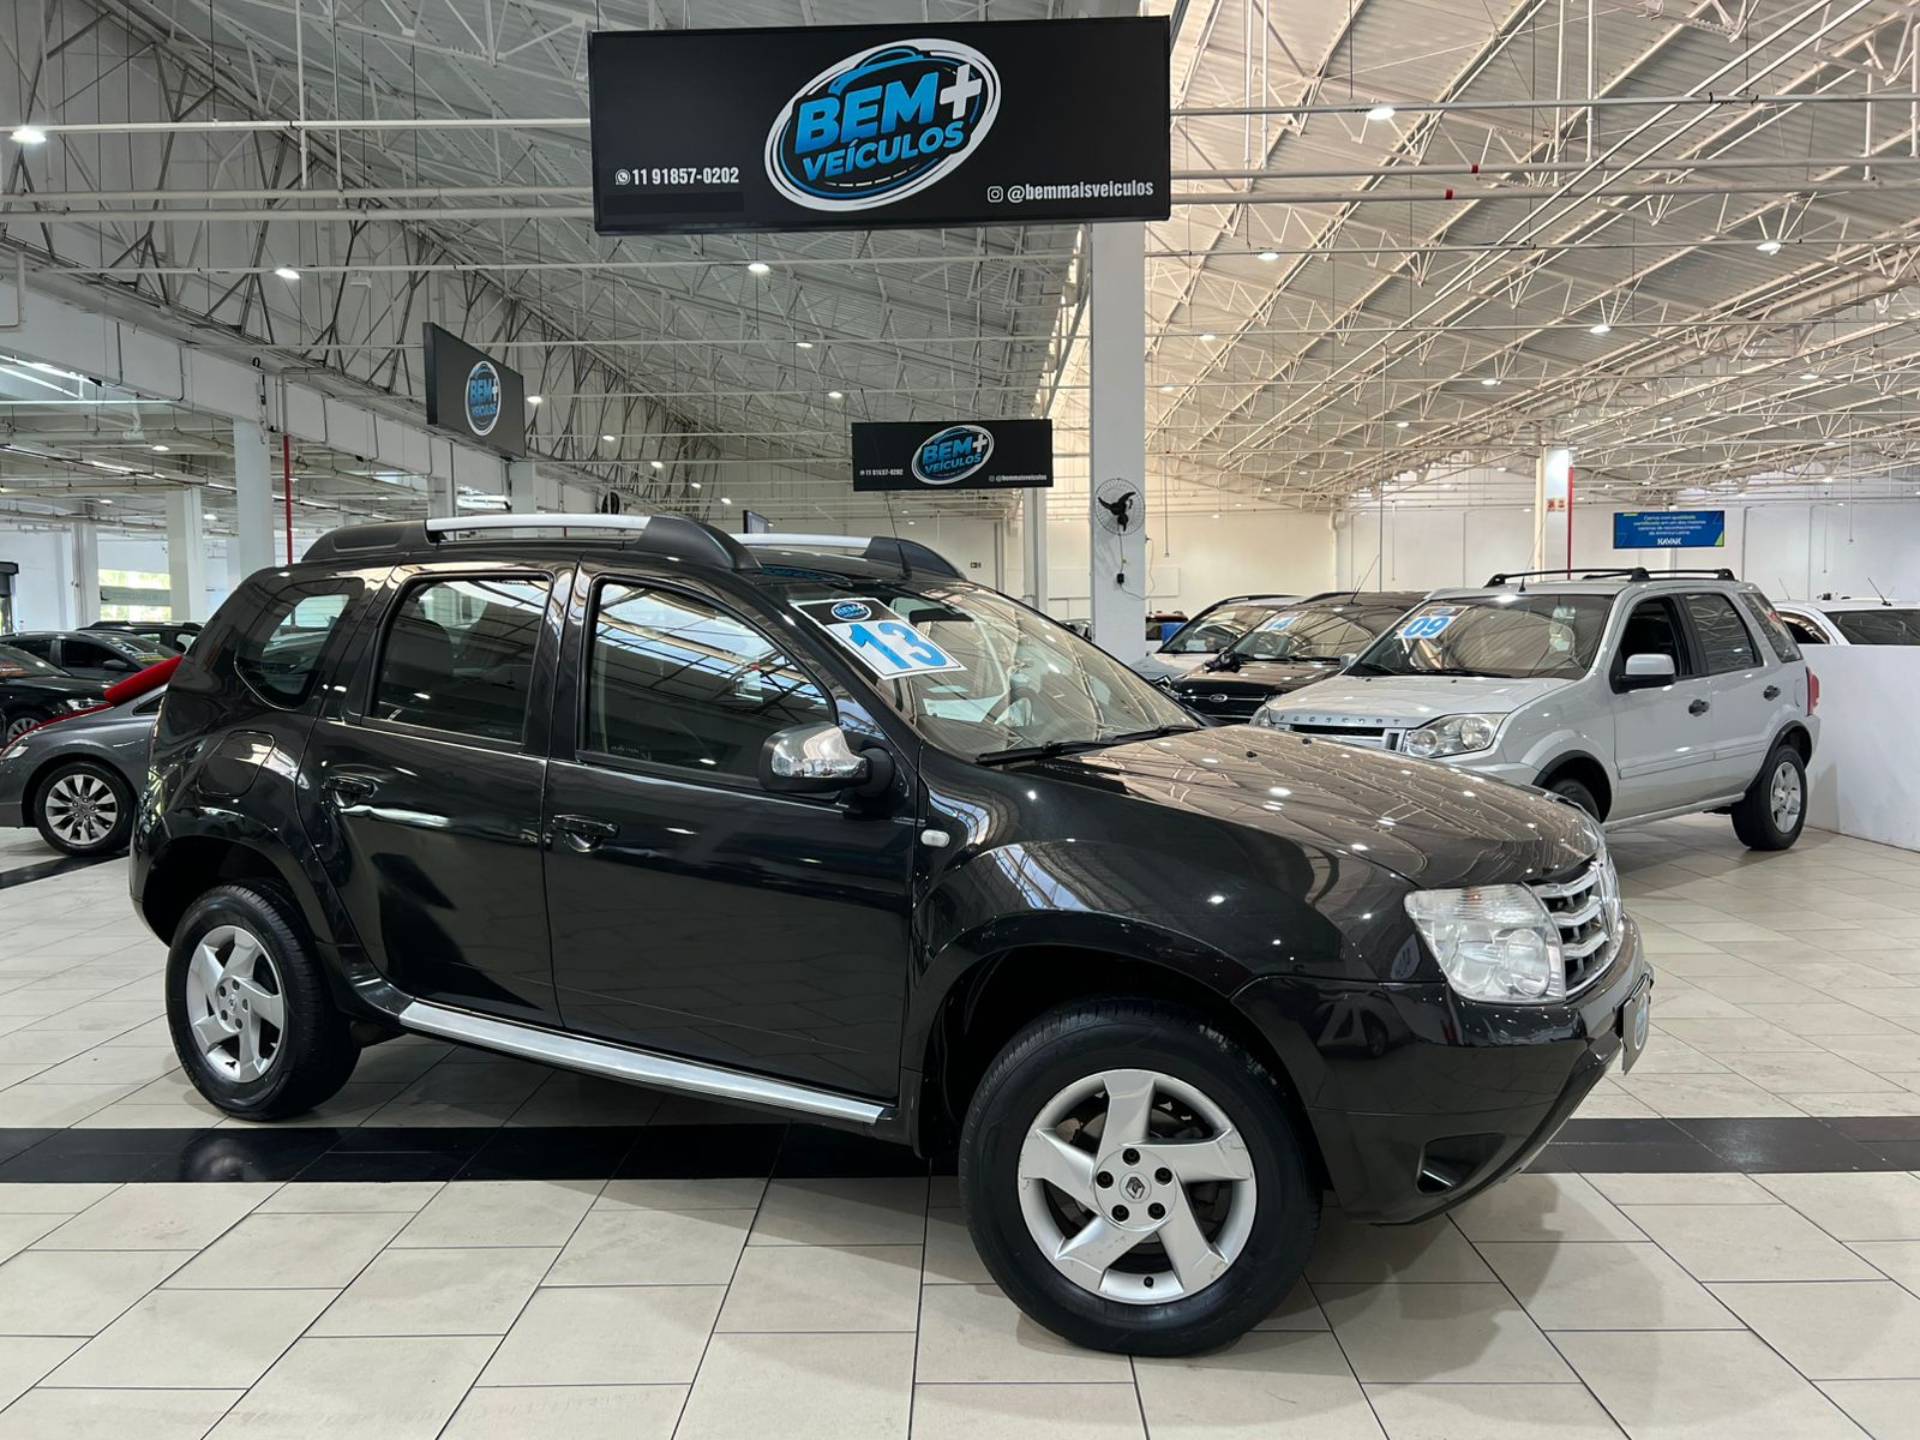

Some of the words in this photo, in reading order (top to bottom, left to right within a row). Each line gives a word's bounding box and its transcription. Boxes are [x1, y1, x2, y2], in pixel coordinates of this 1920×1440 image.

[803, 121, 965, 181] VEÍCULOS
[632, 168, 648, 185] 11
[652, 167, 740, 185] 91857-0202
[1007, 180, 1154, 204] @bemmaisveiculos
[1403, 617, 1450, 637] 09
[849, 622, 947, 669] 13
